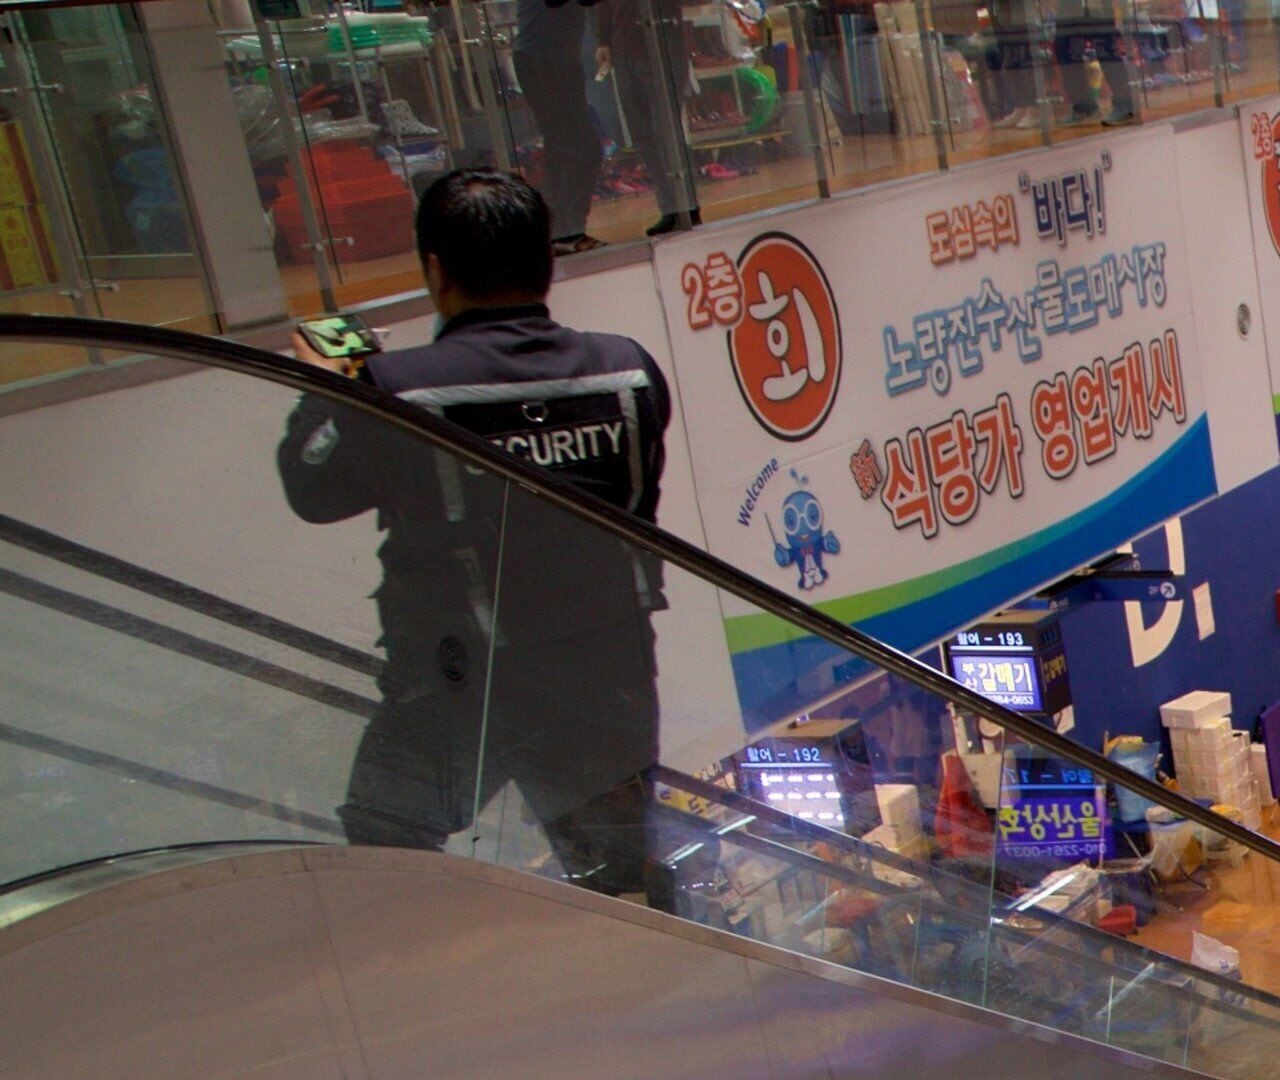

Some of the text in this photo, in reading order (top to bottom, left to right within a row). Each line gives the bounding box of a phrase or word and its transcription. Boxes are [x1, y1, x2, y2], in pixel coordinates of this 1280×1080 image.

[1251, 111, 1273, 160] 2층
[926, 195, 1019, 266] 도심속의
[682, 251, 744, 331] 2층
[882, 242, 1167, 398] 노량진수산물도매시장
[748, 272, 827, 403] 회
[882, 393, 1024, 539] 식당가
[1031, 328, 1188, 479] 영업개시
[737, 456, 781, 530] Welcome
[957, 632, 980, 646] 활어
[998, 632, 1024, 645] 193
[978, 662, 1033, 692] 갈매기
[793, 747, 821, 762] 192
